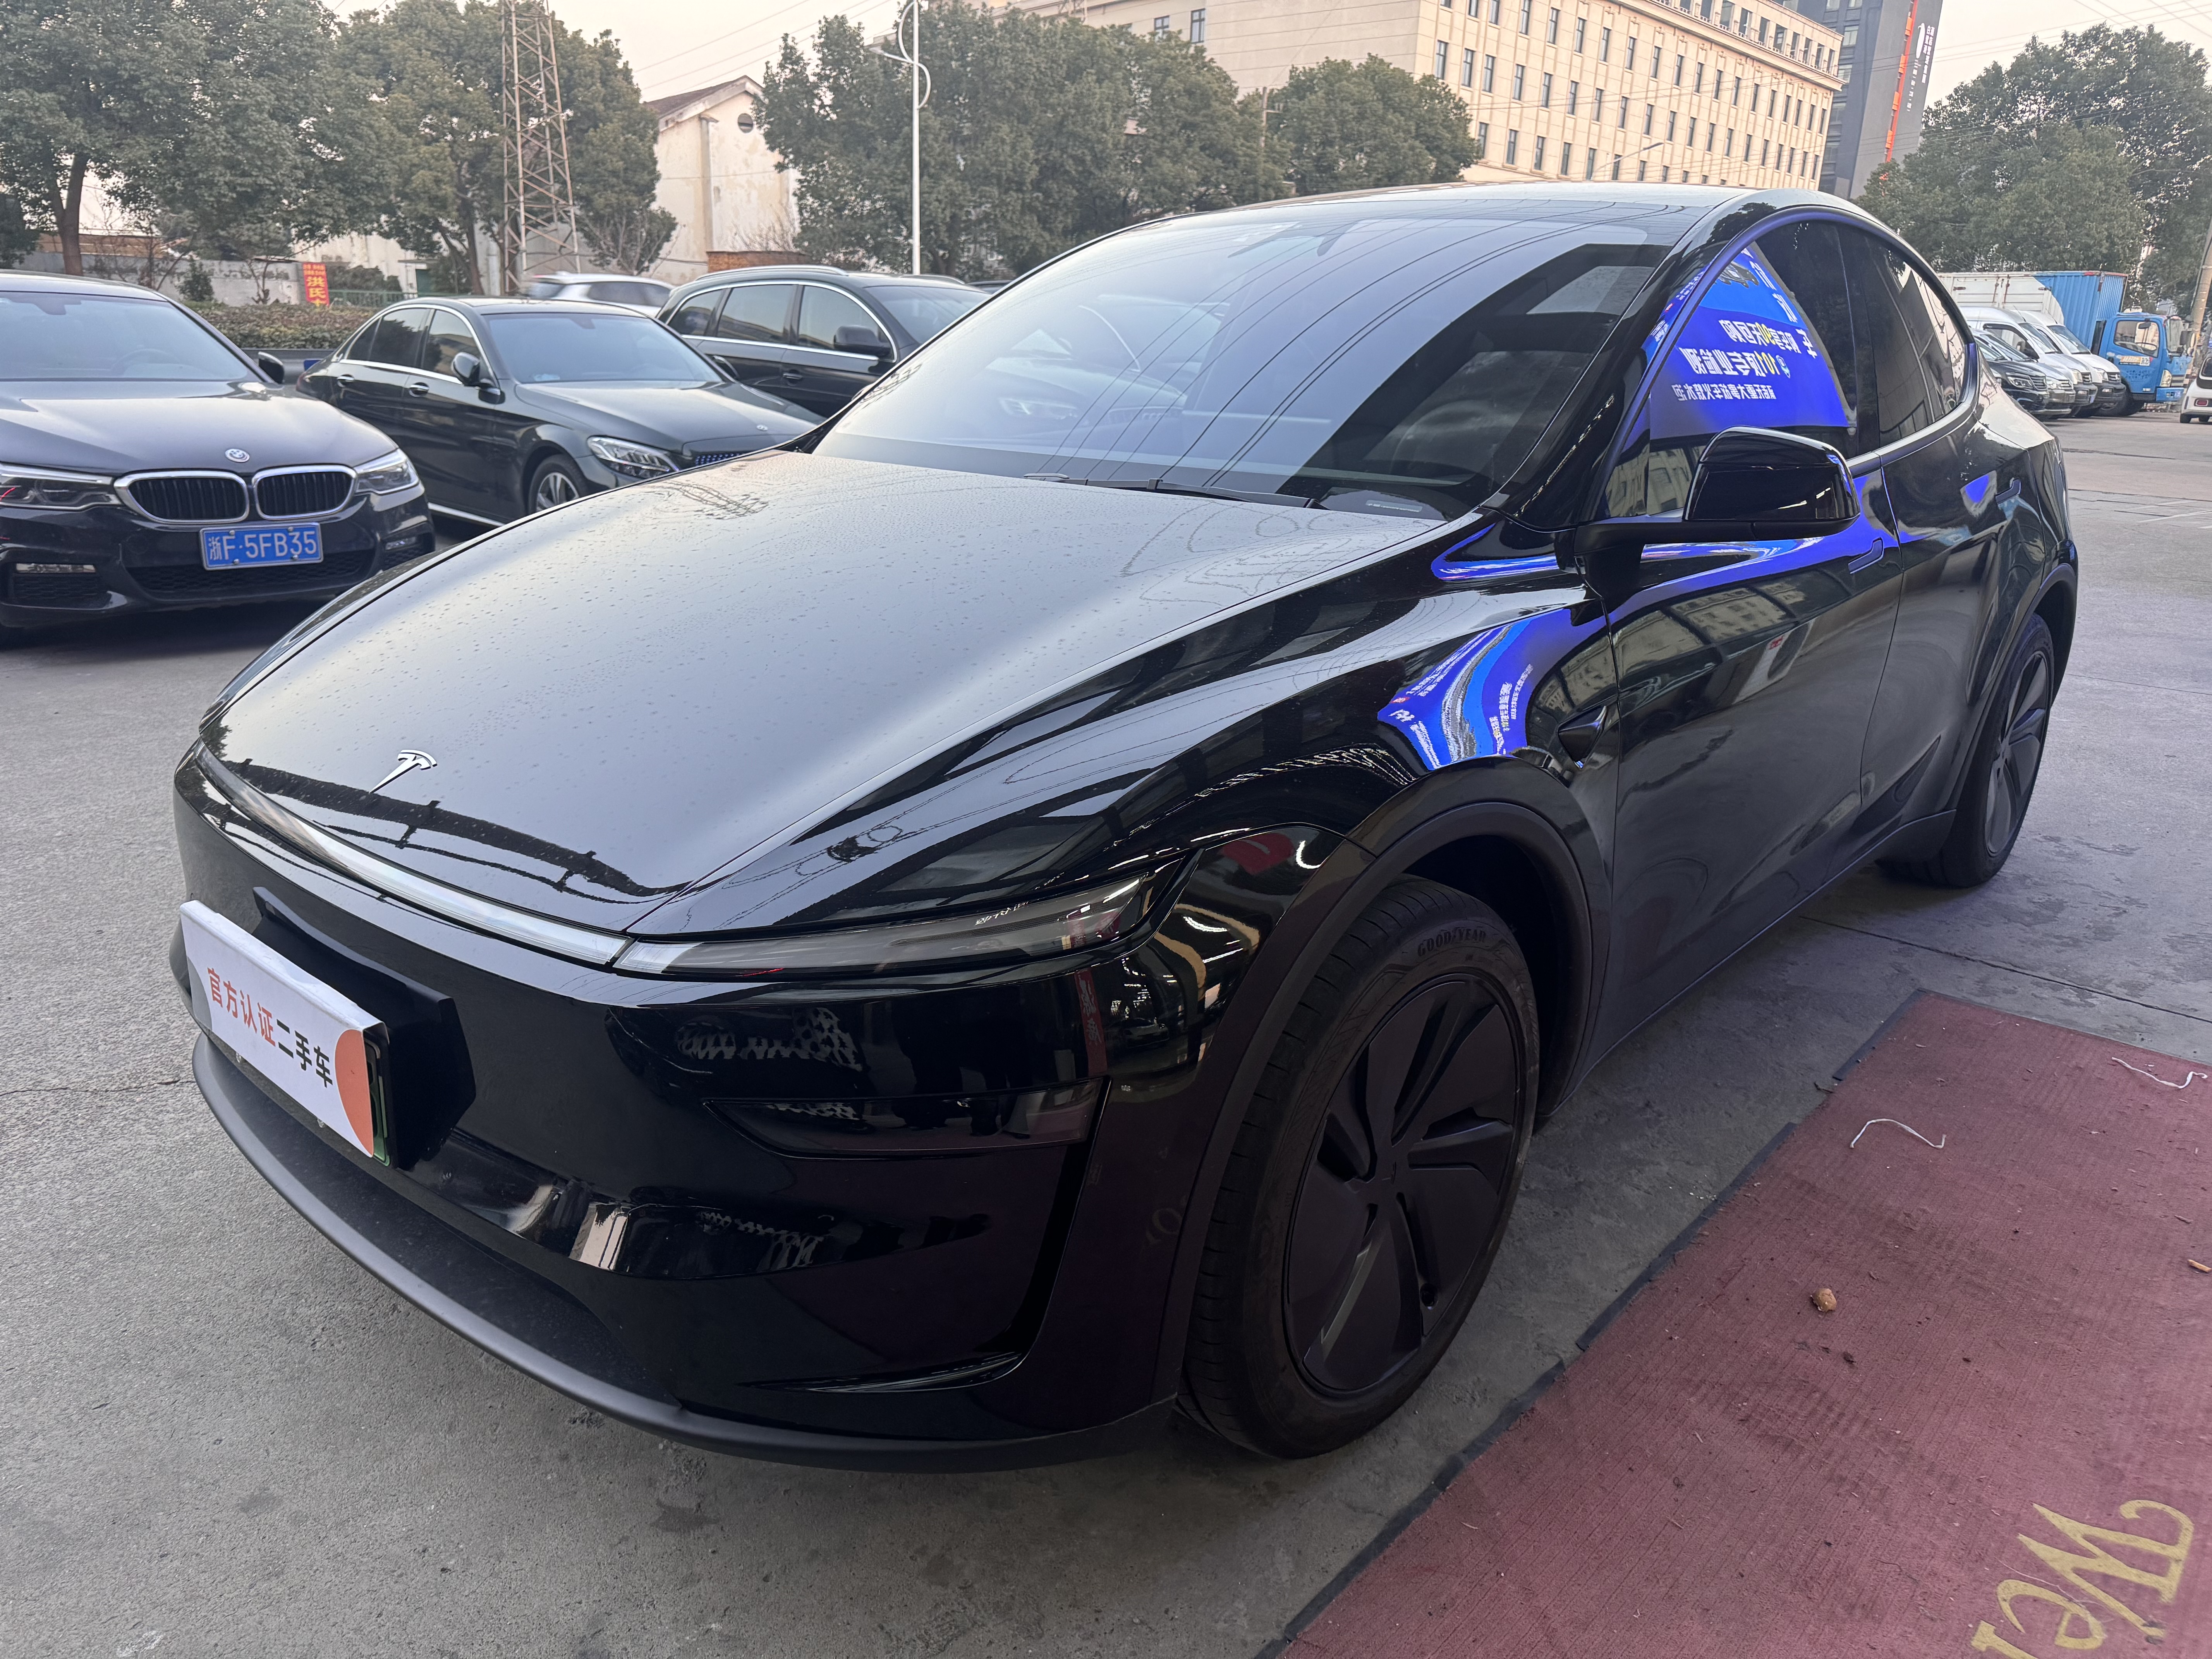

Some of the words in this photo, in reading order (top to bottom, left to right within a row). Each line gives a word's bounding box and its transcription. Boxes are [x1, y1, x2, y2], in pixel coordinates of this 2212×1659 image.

[1417, 929, 1486, 957] GOODYEAR
[208, 967, 333, 1088] 官方认证二手车
